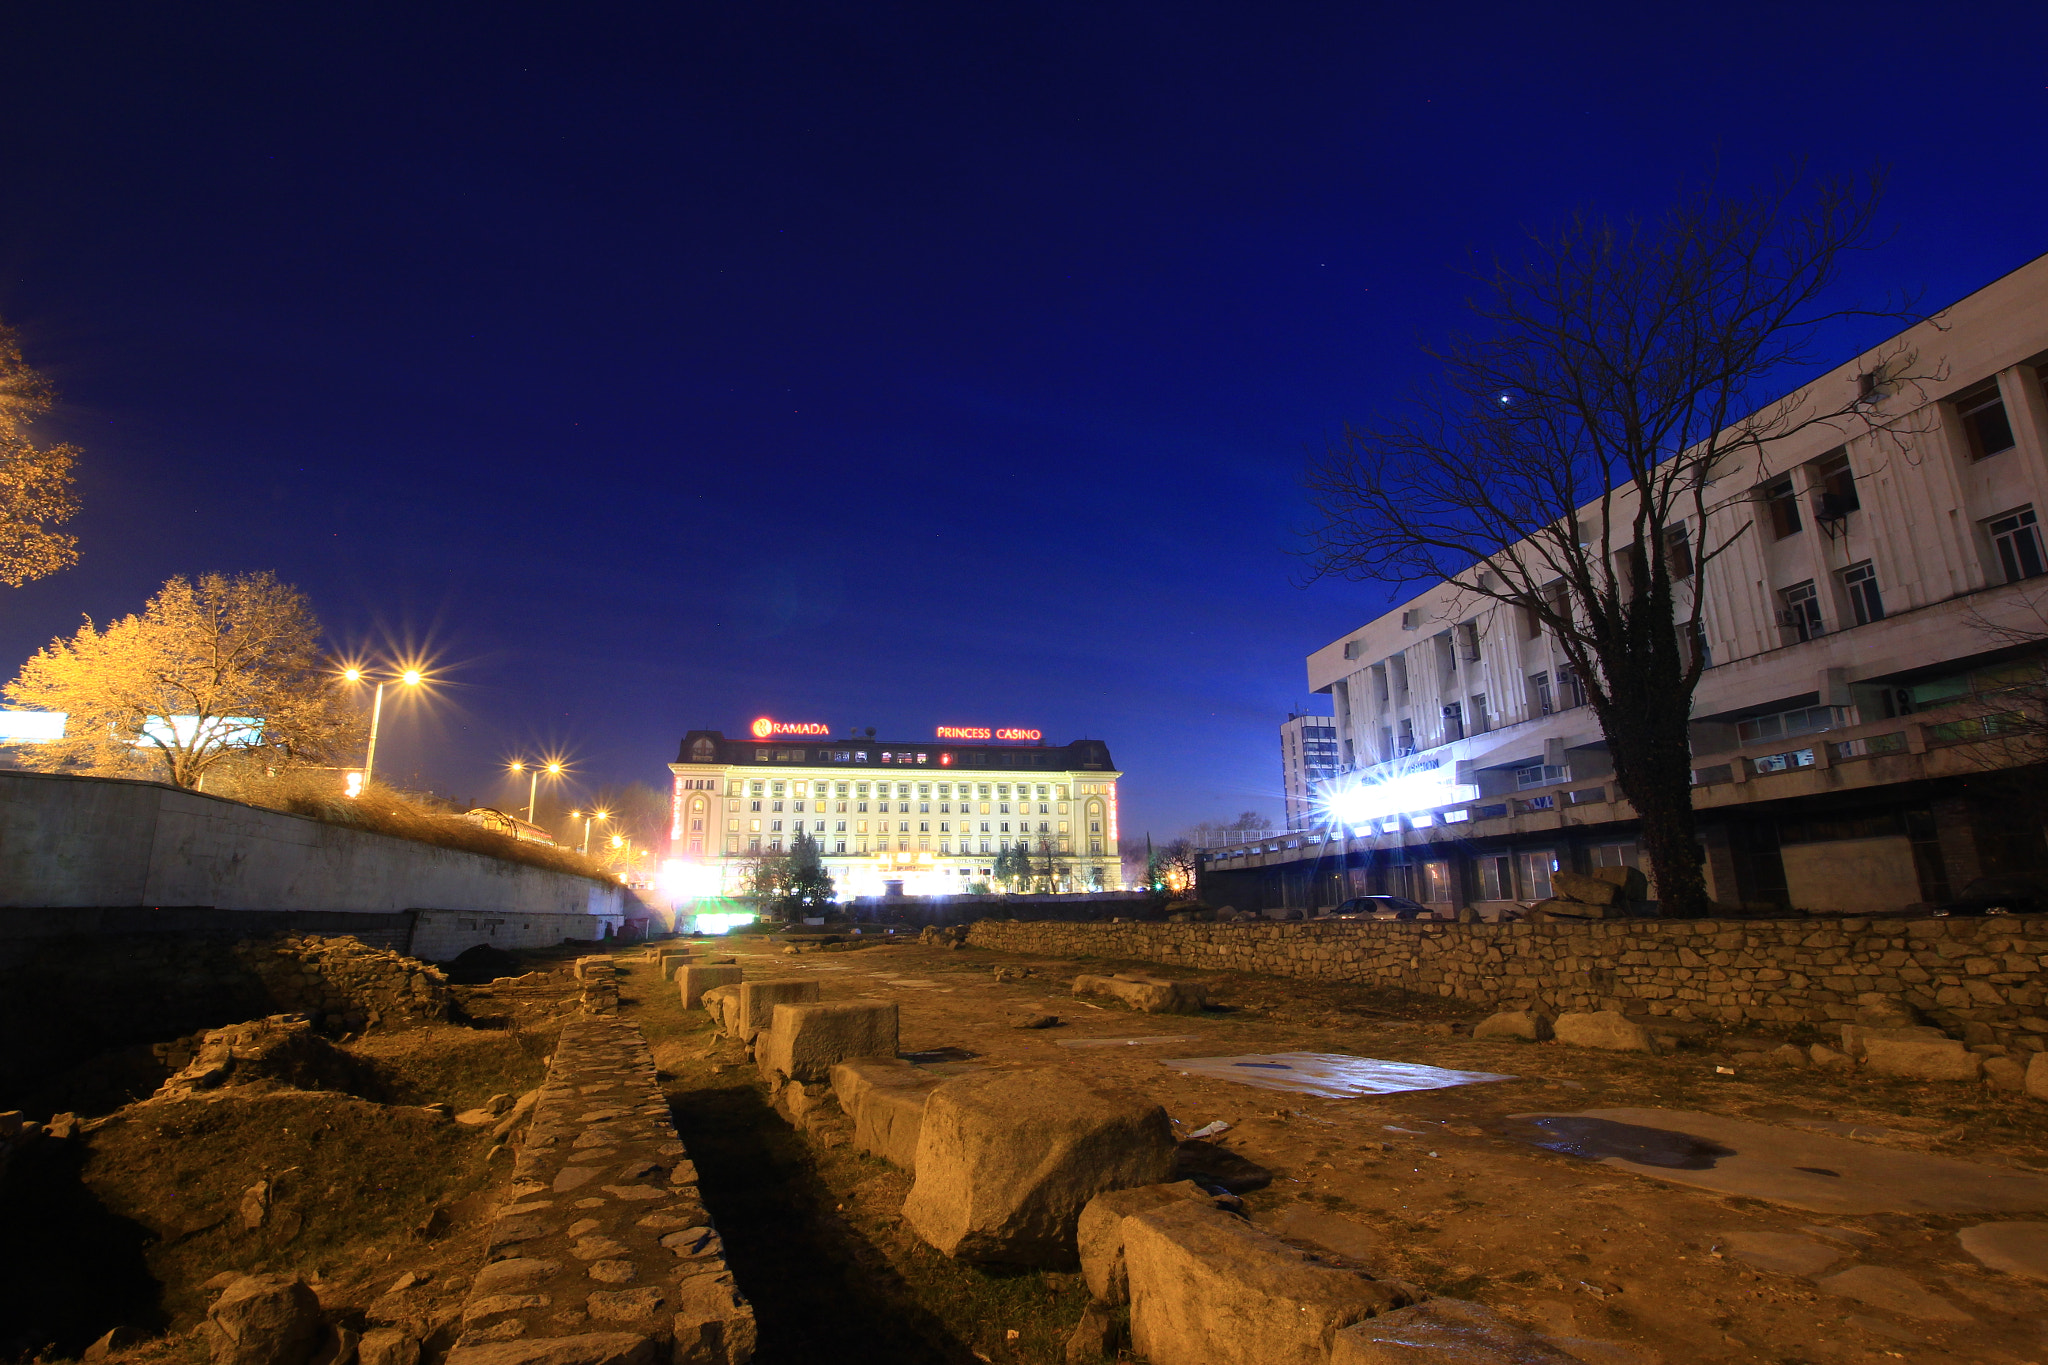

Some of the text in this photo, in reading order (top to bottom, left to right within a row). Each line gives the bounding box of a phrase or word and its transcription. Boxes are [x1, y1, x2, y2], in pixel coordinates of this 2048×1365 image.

[773, 723, 829, 735] RAMADA
[937, 726, 1042, 740] PRINCESS CASINO
